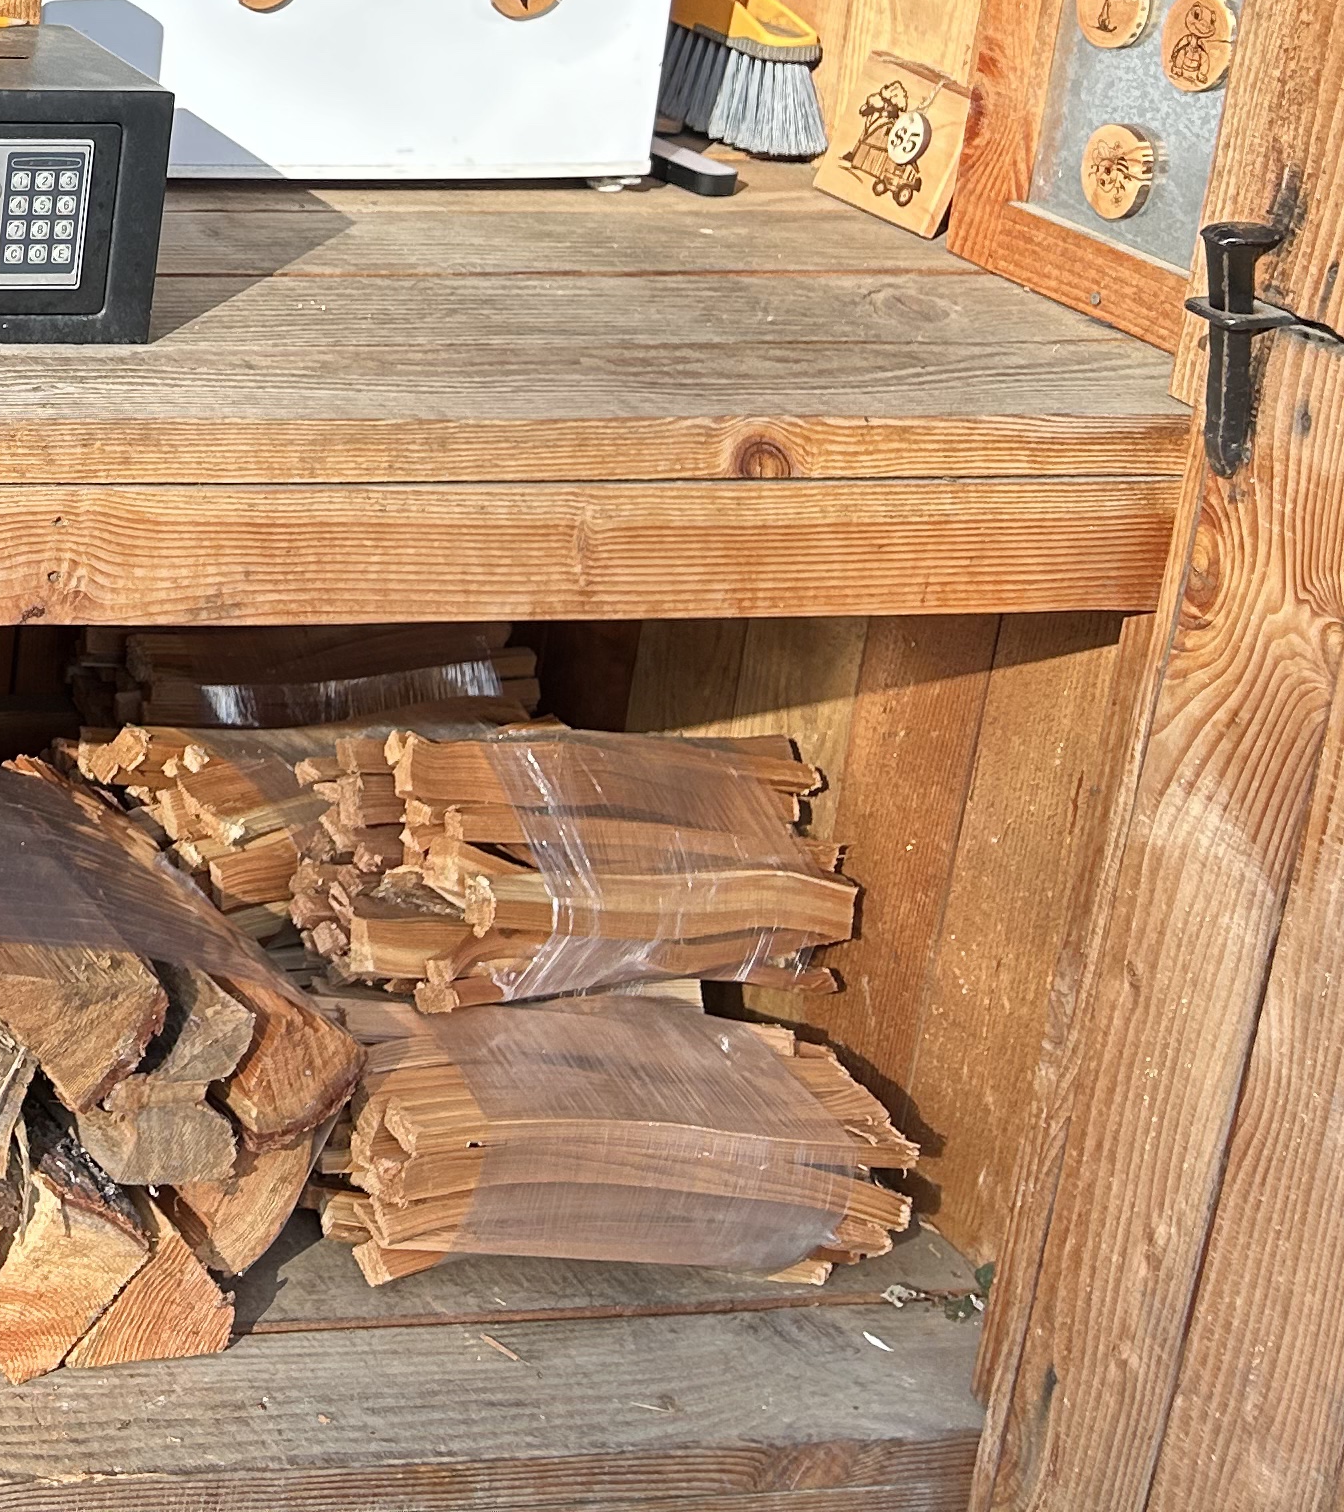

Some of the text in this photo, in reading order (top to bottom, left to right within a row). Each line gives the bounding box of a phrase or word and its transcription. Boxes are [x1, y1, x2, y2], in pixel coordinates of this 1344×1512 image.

[891, 127, 919, 153] $5
[18, 175, 73, 186] 1 2 3
[15, 199, 70, 210] 4 5 6
[13, 224, 68, 235] 7 8 9
[10, 248, 65, 259] C E
